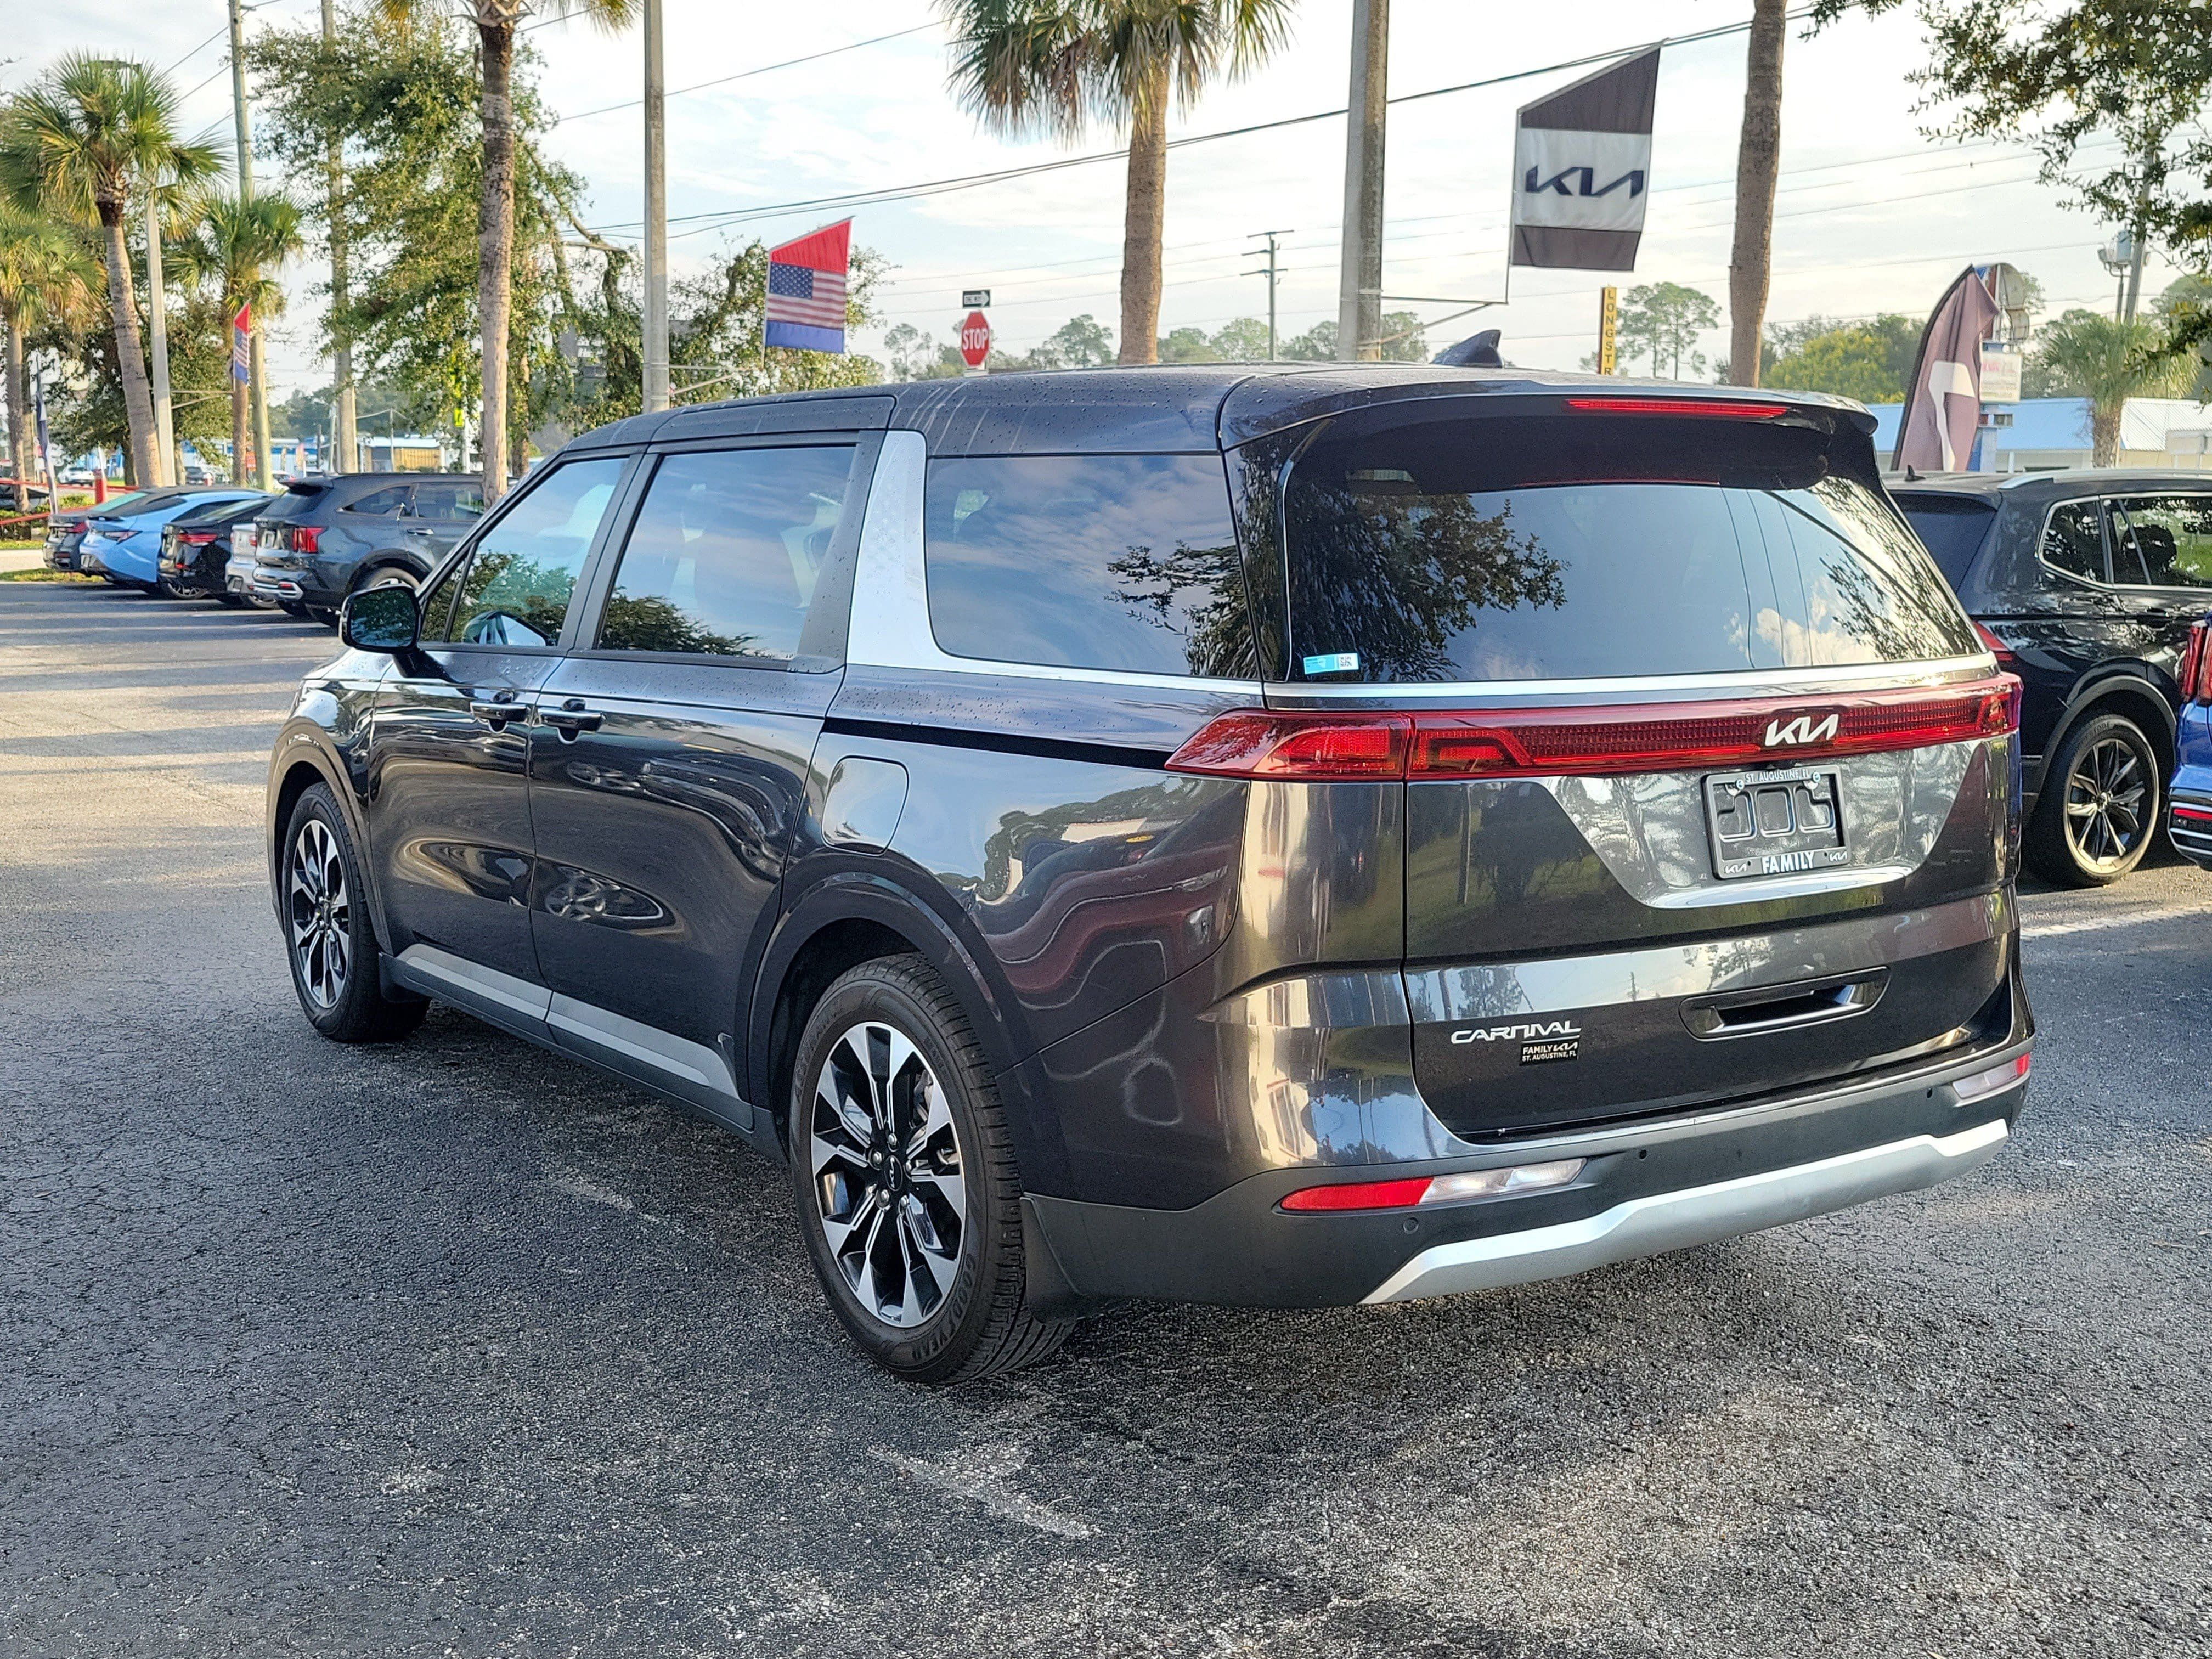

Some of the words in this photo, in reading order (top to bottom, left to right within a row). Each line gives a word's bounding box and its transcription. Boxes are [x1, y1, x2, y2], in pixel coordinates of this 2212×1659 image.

[1526, 165, 1644, 199] KIA
[963, 329, 988, 350] STOP
[1765, 714, 1839, 746] KIA
[1762, 851, 1815, 874] FAMILY
[1829, 851, 1848, 861] KIA
[1725, 862, 1748, 873] KIA
[1451, 1020, 1582, 1043] CARNIVAL
[1523, 1045, 1553, 1055] FAMILY
[1553, 1042, 1578, 1051] KIA
[1532, 1052, 1568, 1060] AUGUSTINE,
[911, 1253, 976, 1360] GOODYEAR
